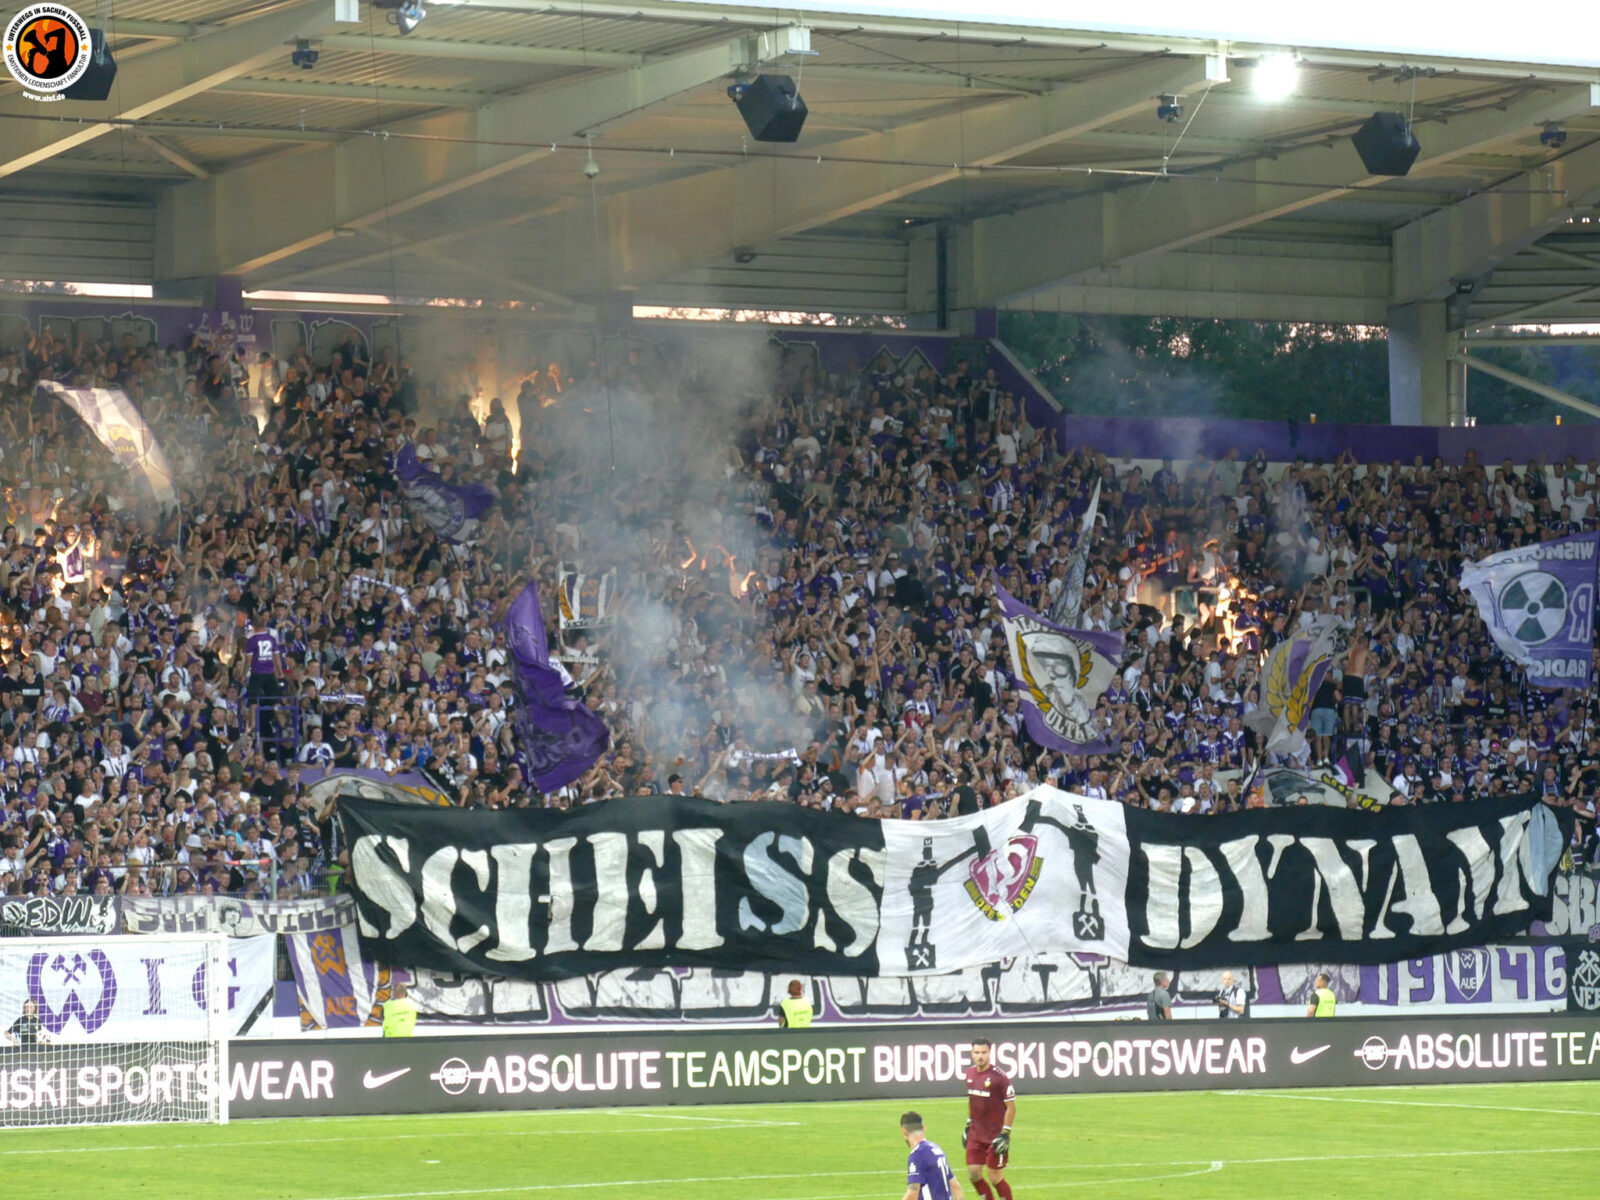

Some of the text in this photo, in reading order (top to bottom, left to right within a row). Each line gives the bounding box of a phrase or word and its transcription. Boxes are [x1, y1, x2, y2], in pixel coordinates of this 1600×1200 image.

[258, 641, 272, 657] 12
[352, 828, 888, 962] SCHEISS
[1460, 977, 1477, 990] AUE
[326, 996, 357, 1016] AUE
[478, 1052, 661, 1095] ABSOLUTE
[665, 1047, 866, 1088] TEAMSPORT
[1053, 1037, 1267, 1079] SPORTSWEAR
[1394, 1032, 1548, 1070] ABSOLUTE
[77, 1060, 334, 1106] SPORTSWEAR
